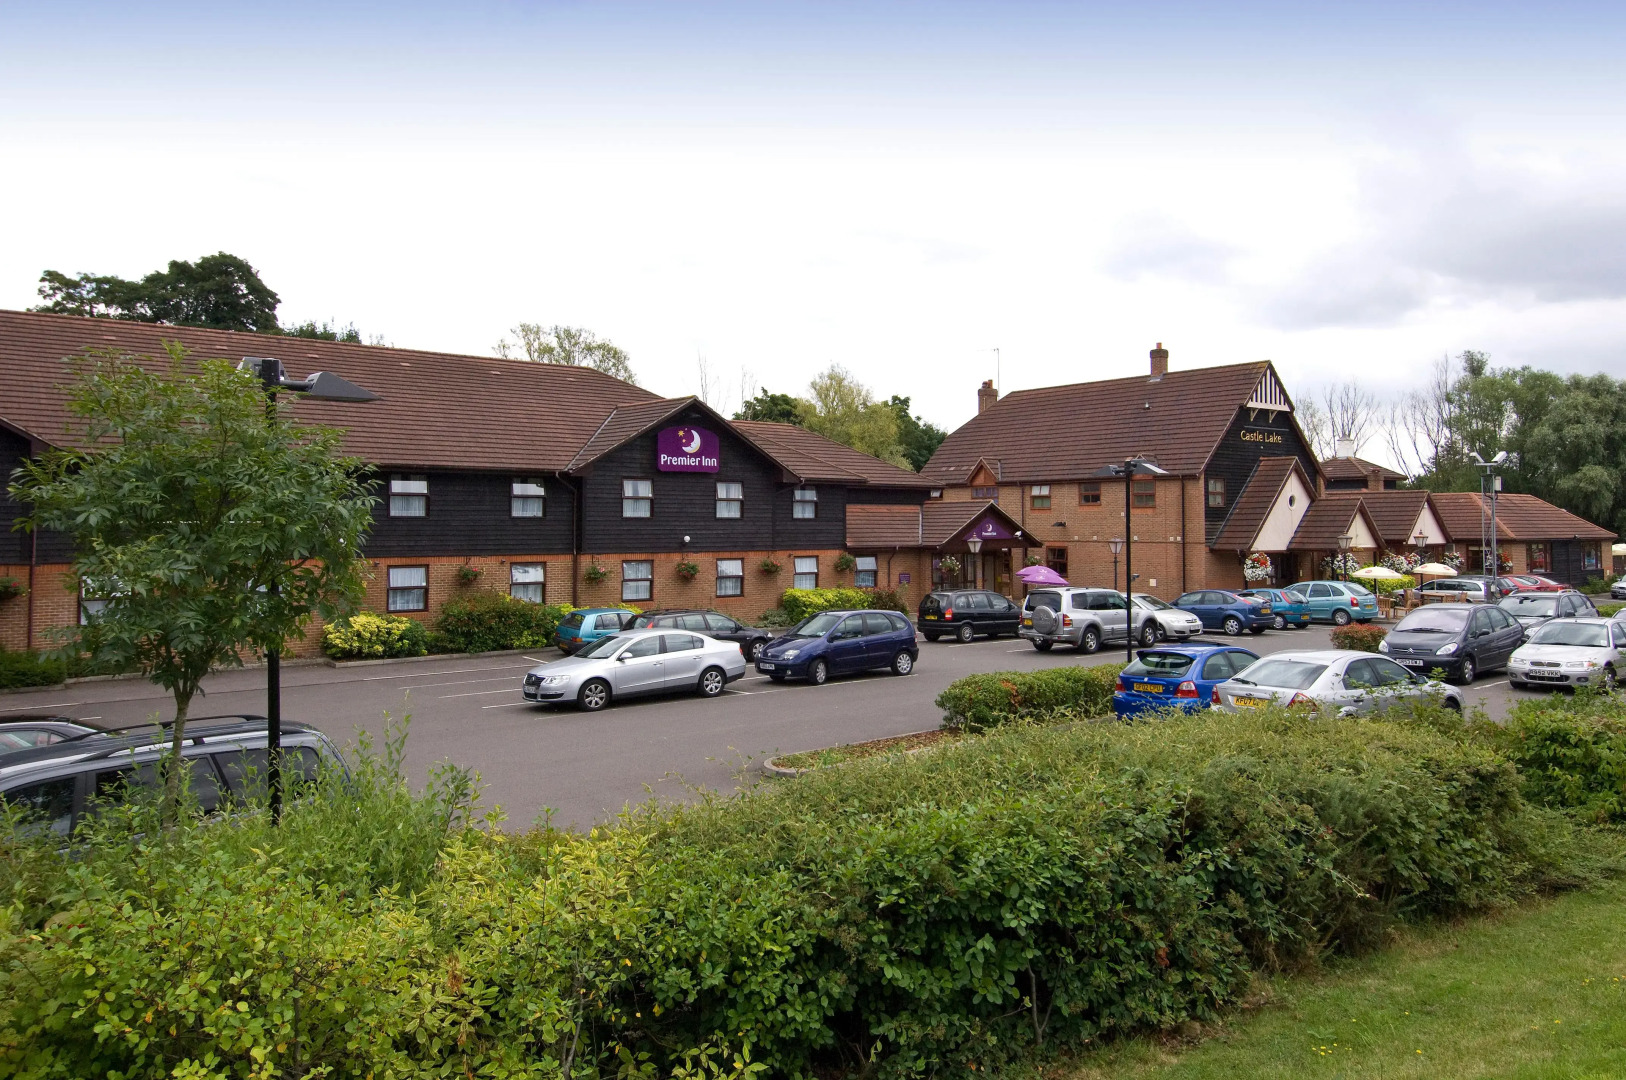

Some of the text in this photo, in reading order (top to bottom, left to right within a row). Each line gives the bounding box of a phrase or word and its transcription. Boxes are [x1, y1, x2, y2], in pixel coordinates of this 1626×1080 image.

[1241, 431, 1282, 443] Castle Lake
[661, 454, 717, 466] Premier Inn
